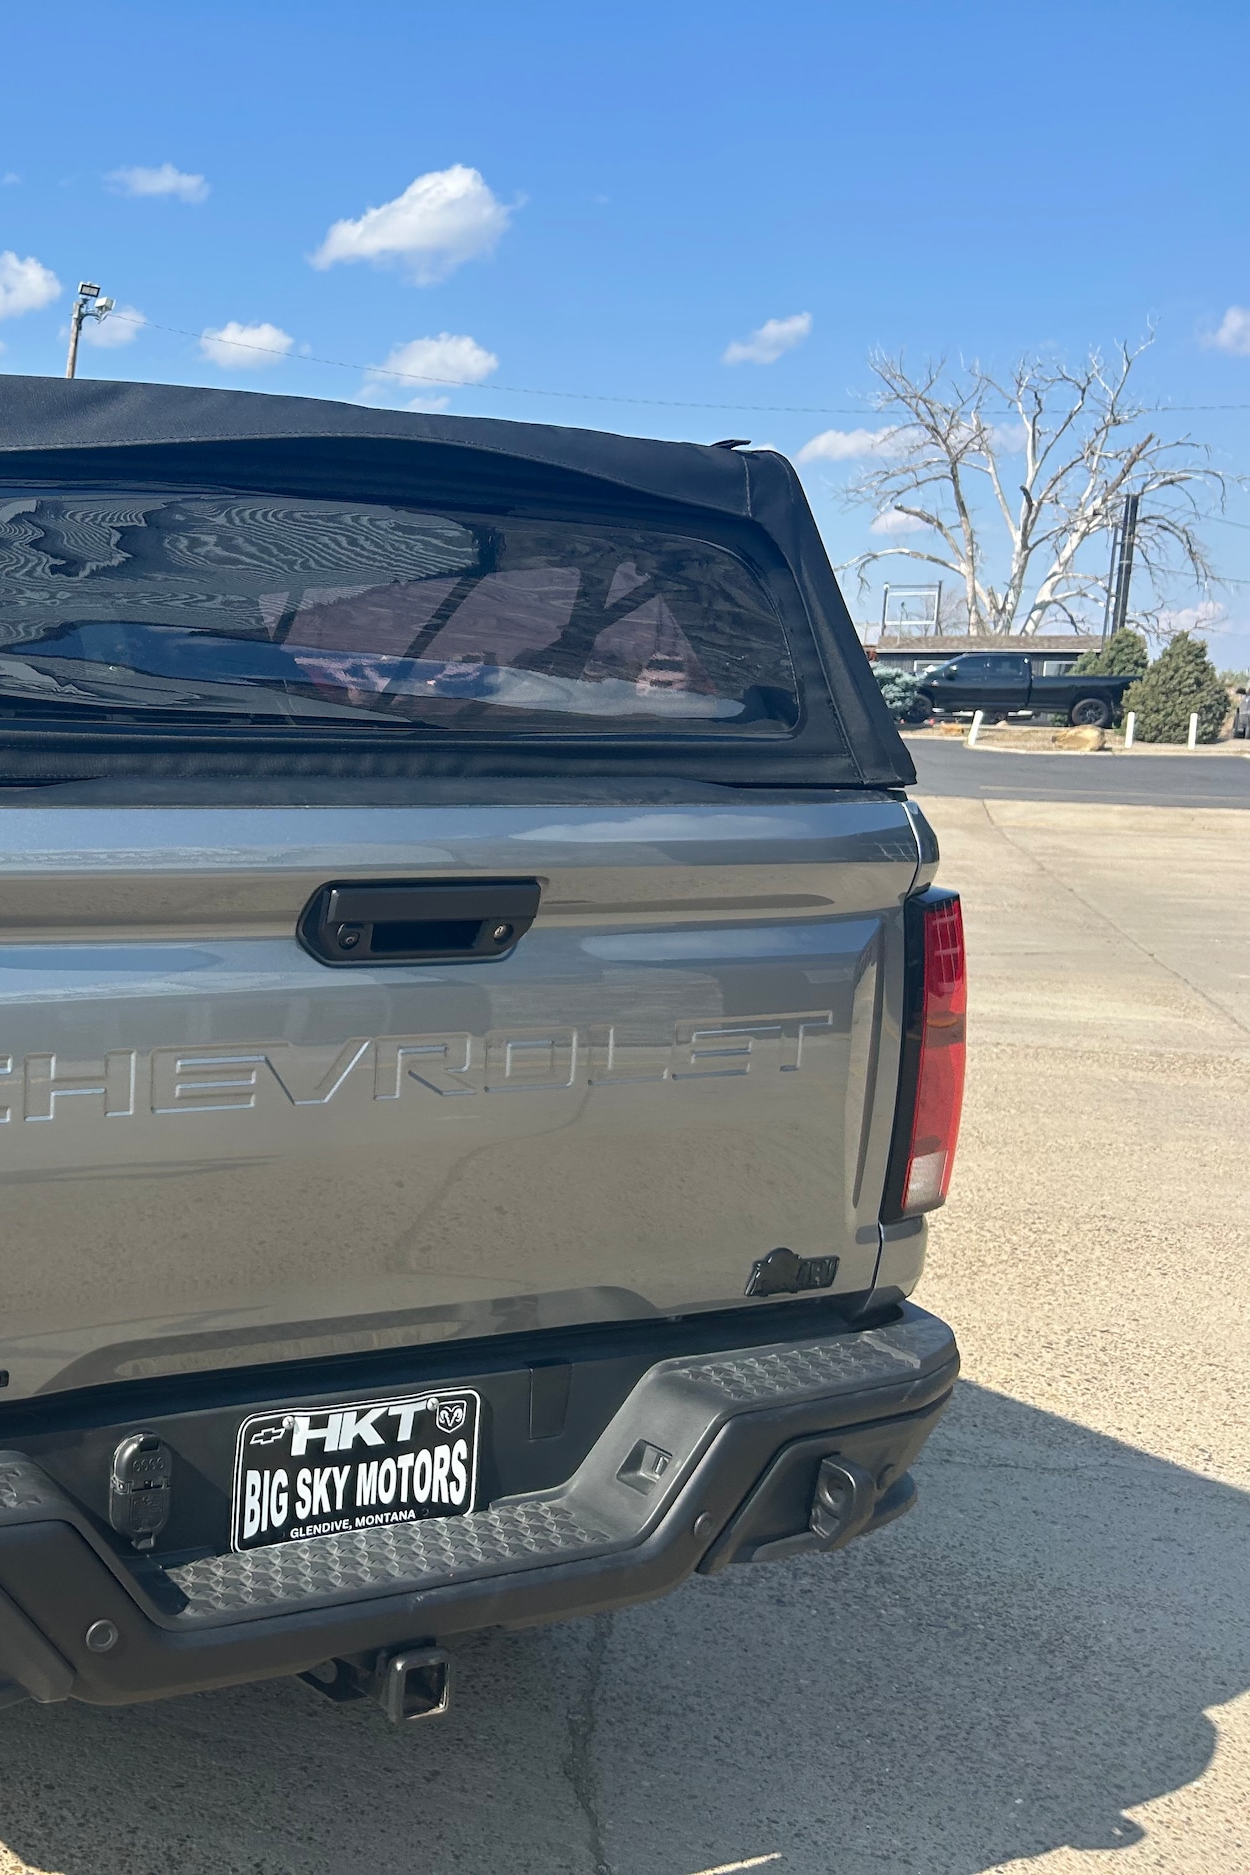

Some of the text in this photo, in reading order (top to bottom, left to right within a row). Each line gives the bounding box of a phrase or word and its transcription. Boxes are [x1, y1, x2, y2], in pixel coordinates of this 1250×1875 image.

[291, 1400, 428, 1457] HKT
[243, 1468, 289, 1540] BIG
[295, 1465, 351, 1520] SKY
[356, 1438, 468, 1507] MOTORS
[290, 1509, 416, 1540] GLENDIVE, MONTANA
